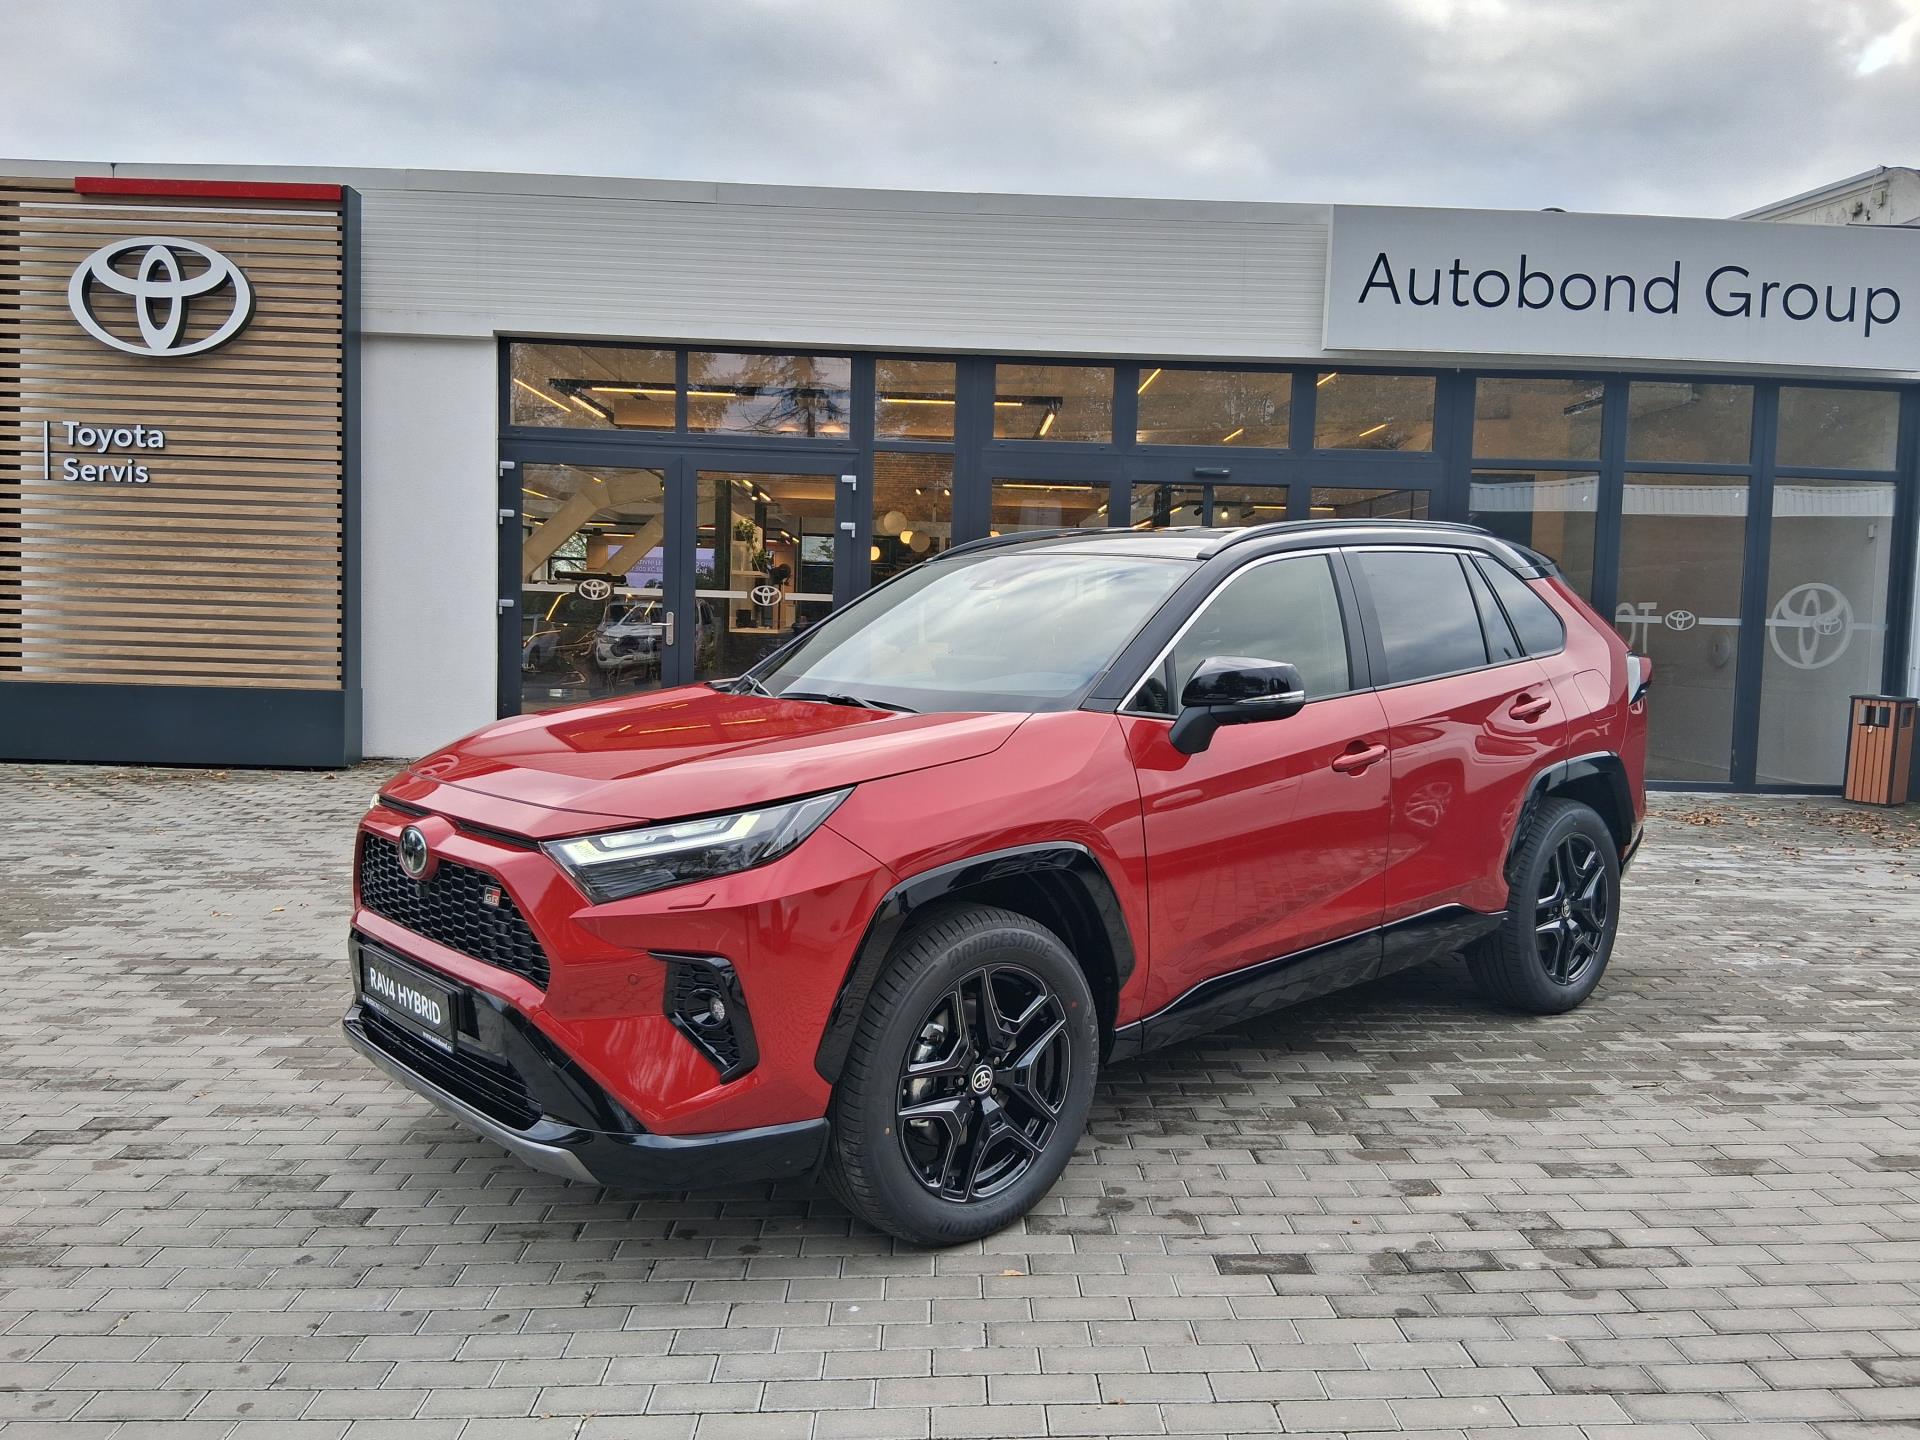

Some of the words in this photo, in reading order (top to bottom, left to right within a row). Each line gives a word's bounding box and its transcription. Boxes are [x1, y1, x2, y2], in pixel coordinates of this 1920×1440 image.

[1358, 252, 1681, 315] Autobond
[1705, 265, 1901, 338] Group
[62, 421, 165, 453] Toyota
[63, 457, 150, 483] Servis
[947, 931, 1053, 969] BRIDGESTONE
[370, 966, 396, 1001] RAV4
[398, 983, 441, 1025] HYBRID
